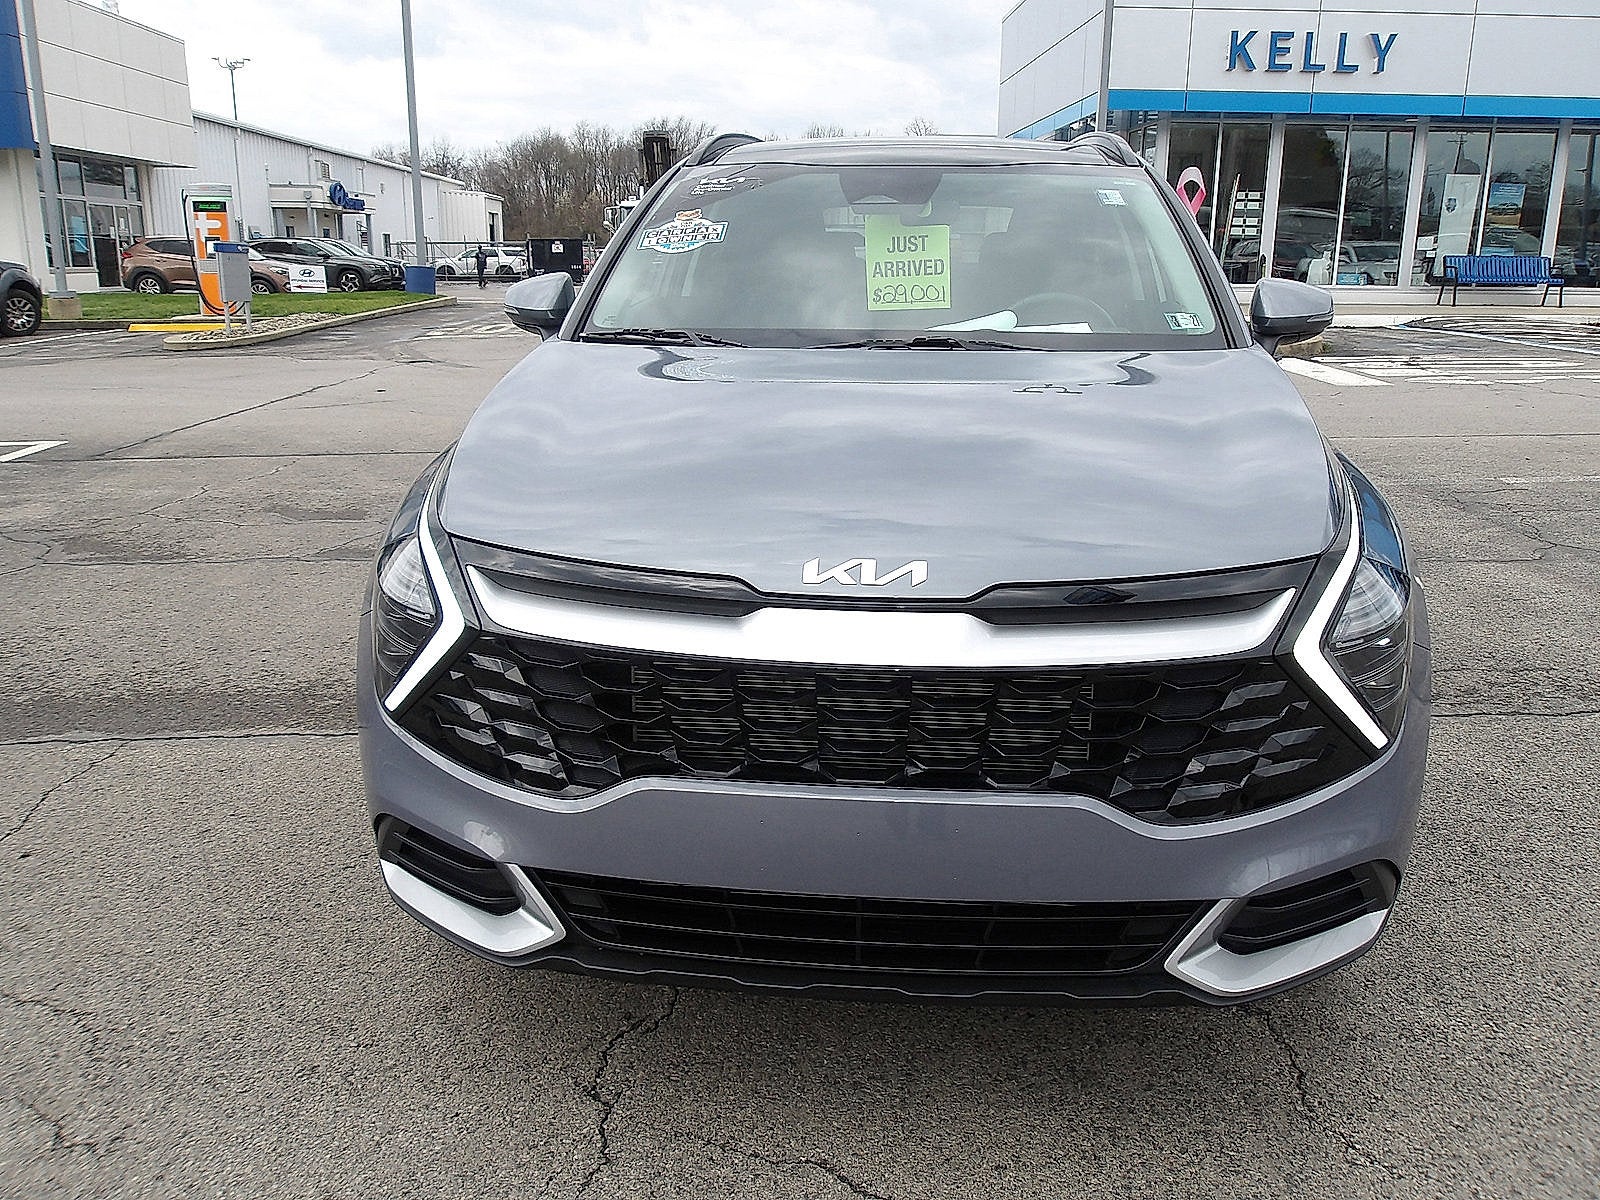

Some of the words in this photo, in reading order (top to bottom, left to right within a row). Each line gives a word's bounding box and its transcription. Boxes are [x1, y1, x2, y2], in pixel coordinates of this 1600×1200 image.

[1226, 30, 1399, 74] KELLY
[887, 235, 929, 253] JUST
[872, 258, 945, 278] ARRIVED
[802, 556, 928, 588] KIA
